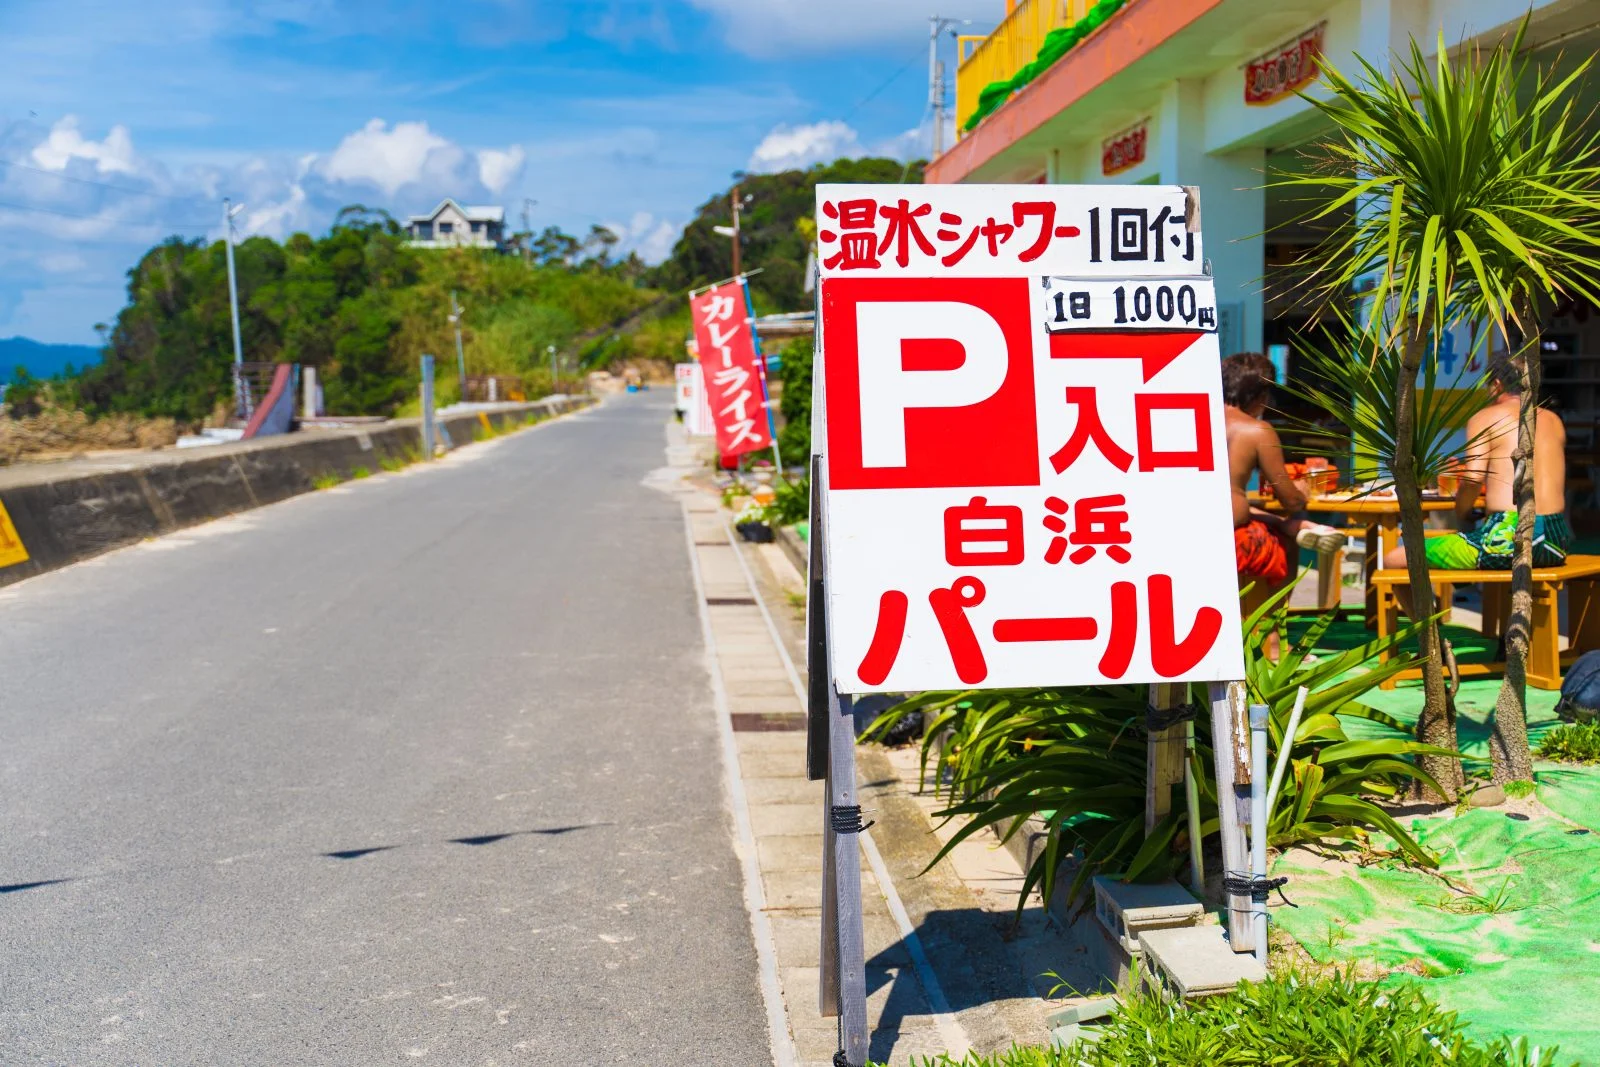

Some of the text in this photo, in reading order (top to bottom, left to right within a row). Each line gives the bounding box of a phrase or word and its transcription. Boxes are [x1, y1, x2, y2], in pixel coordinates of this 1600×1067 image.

[700, 295, 763, 450] カレーライス
[855, 301, 1009, 468] P
[1048, 386, 1215, 475] 入口
[943, 493, 1132, 567] 白浜
[857, 573, 1223, 686] パール
